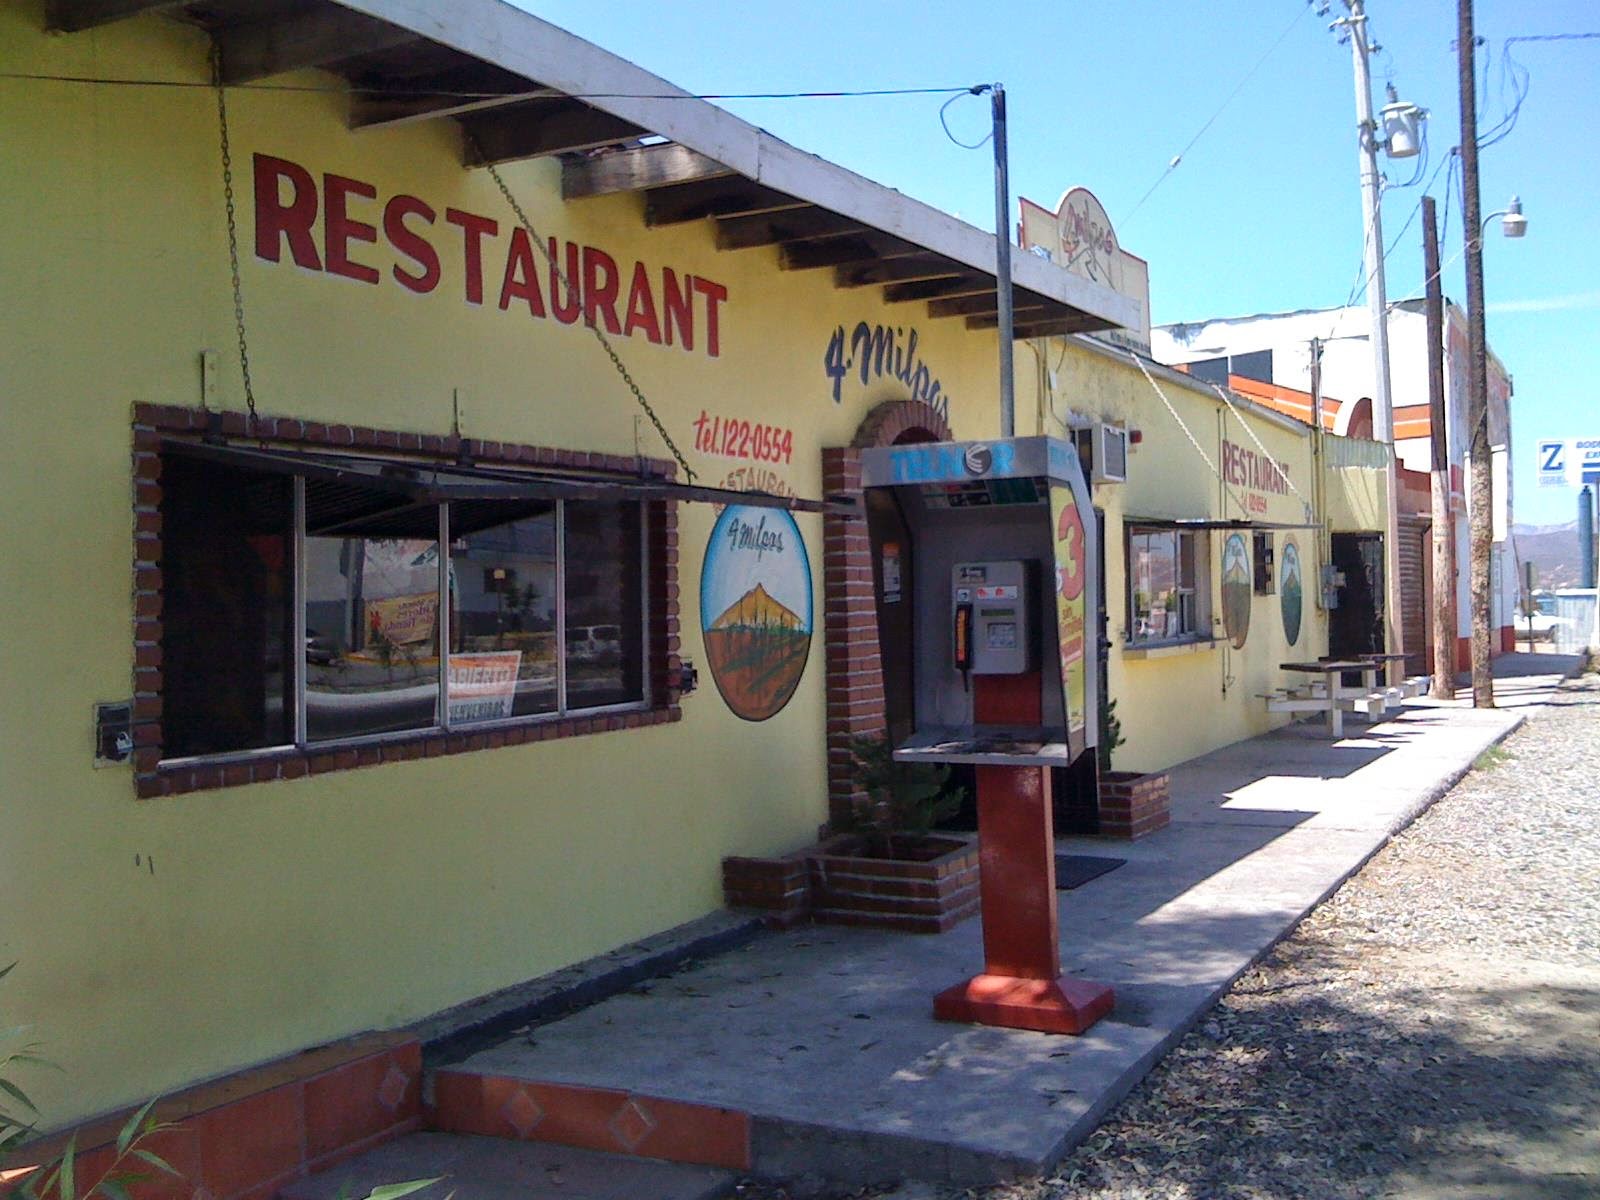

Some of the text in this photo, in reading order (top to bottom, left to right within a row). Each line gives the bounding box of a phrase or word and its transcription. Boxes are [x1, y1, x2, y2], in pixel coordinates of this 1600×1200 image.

[253, 152, 728, 357] RESTAURANT
[1222, 440, 1289, 496] RESTAURANT
[1542, 444, 1563, 471] Z
